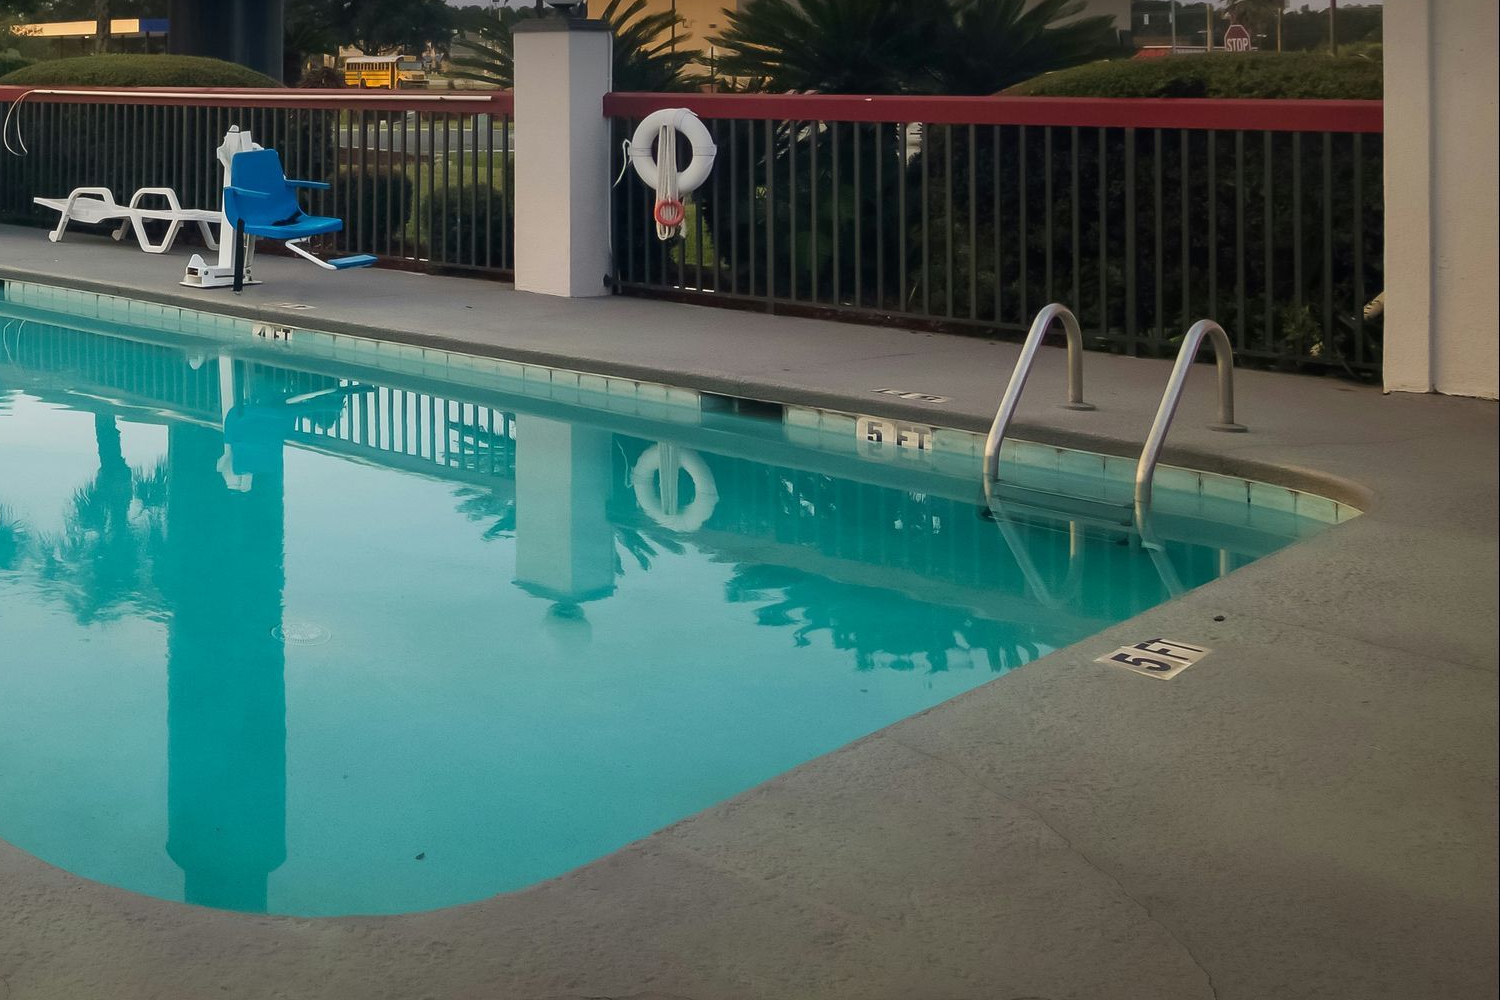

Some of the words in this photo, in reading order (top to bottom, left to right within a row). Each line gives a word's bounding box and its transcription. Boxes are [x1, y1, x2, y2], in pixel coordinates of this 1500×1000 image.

[1226, 37, 1249, 51] STOP
[867, 420, 883, 443] 5
[896, 424, 932, 450] FT
[1134, 638, 1204, 661] FT
[1110, 653, 1172, 672] 5
